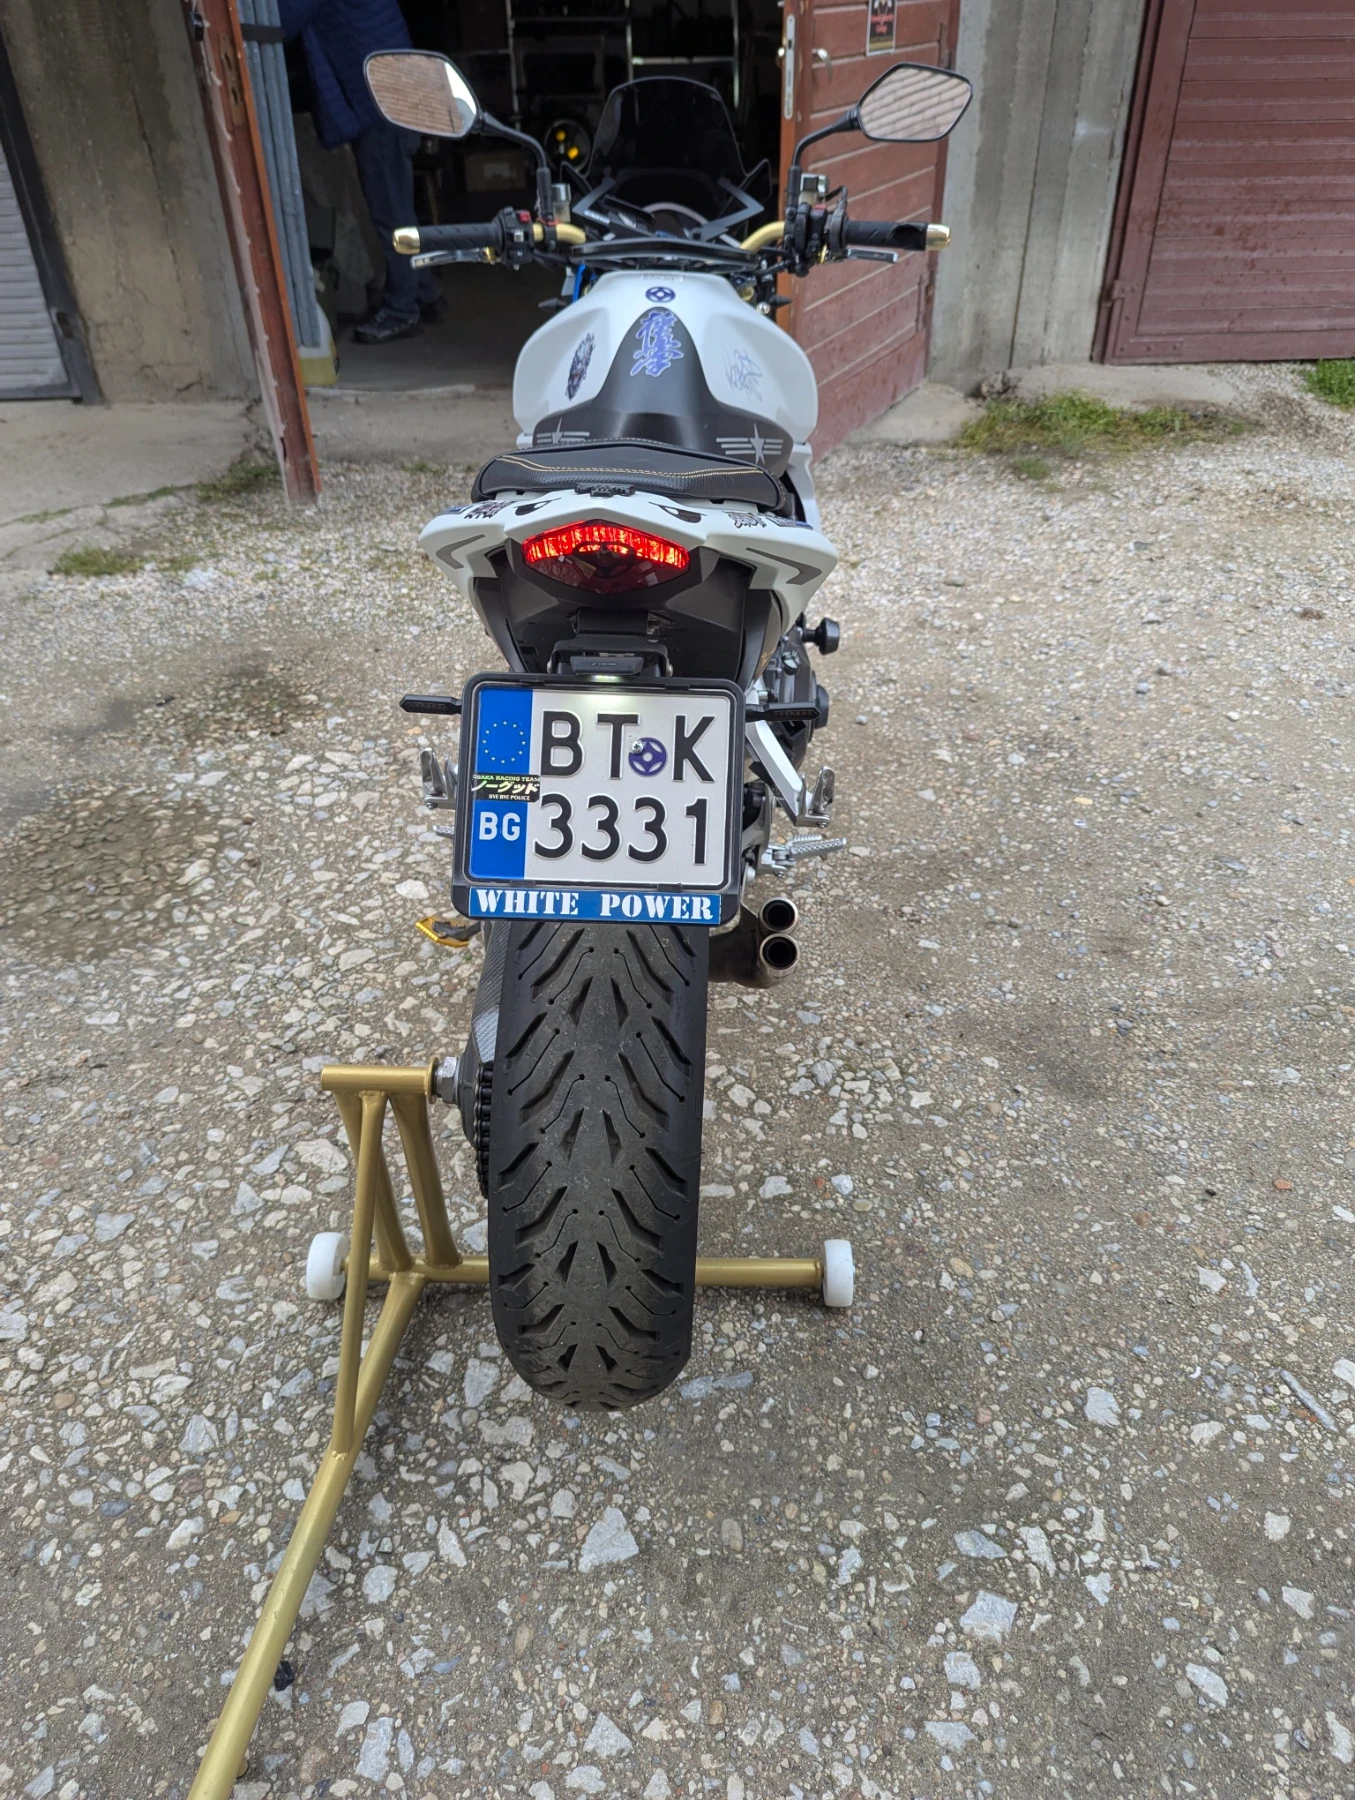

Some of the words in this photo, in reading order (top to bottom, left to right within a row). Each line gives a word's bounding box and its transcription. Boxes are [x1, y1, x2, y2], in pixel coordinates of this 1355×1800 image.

[471, 780, 540, 794] ノーグッド
[478, 811, 521, 842] BG
[534, 793, 707, 865] 3331
[476, 890, 579, 915] WHITE
[601, 894, 713, 920] POWER
